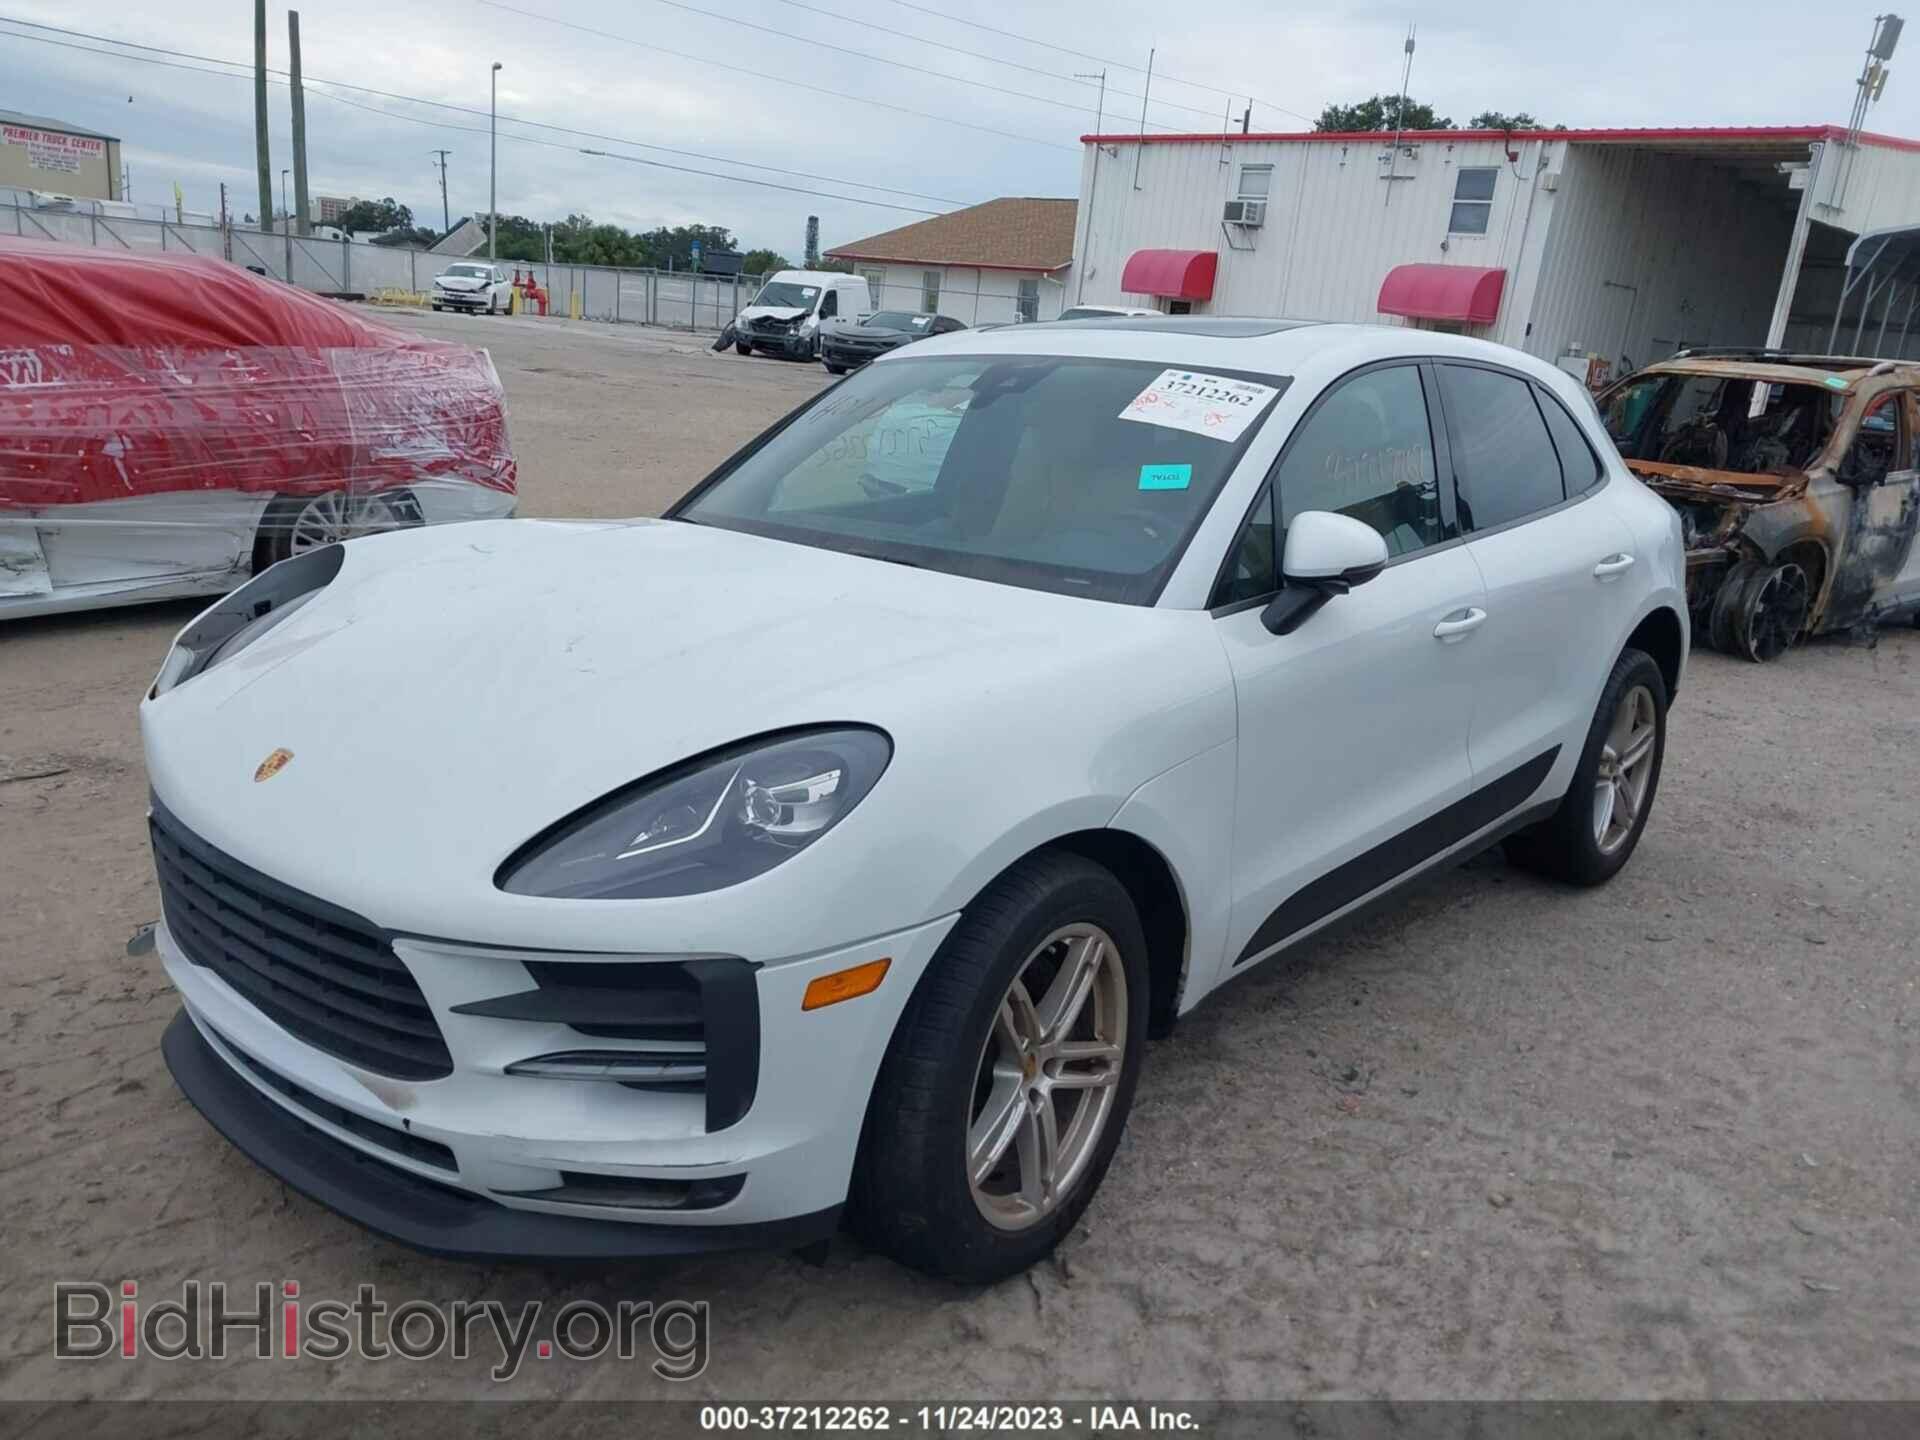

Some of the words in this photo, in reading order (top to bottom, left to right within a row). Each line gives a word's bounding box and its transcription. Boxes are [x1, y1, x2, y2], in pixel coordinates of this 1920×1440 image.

[3, 127, 39, 141] PREMIER
[41, 133, 67, 145] TRUCK
[71, 137, 102, 150] CENTER
[1160, 380, 1254, 406] 37212262
